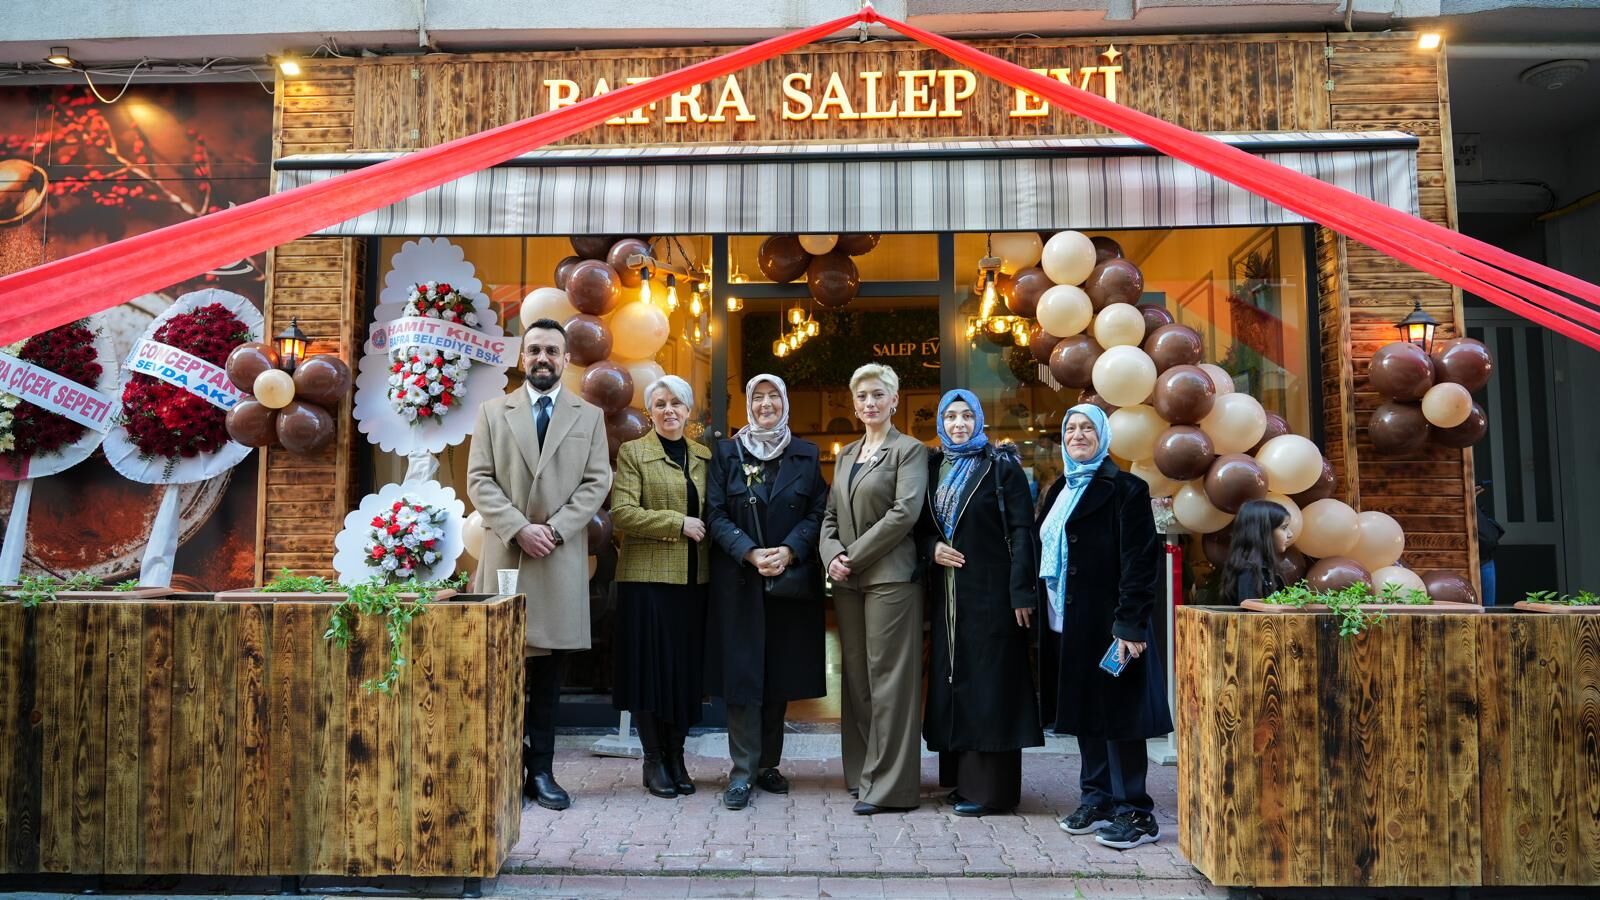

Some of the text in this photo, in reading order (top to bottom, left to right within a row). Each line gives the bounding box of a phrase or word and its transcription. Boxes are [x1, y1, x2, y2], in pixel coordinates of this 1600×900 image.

[782, 69, 977, 120] SALEP
[388, 321, 505, 354] HAMİT KILIÇ
[390, 335, 410, 348] BAFRA
[413, 333, 473, 355] BELEDİYE
[475, 348, 503, 364] BŞK.
[873, 343, 916, 357] SALEP
[135, 359, 188, 386] SEVDA
[8, 365, 57, 400] ÇİÇEK
[53, 385, 112, 423] SEPETİ
